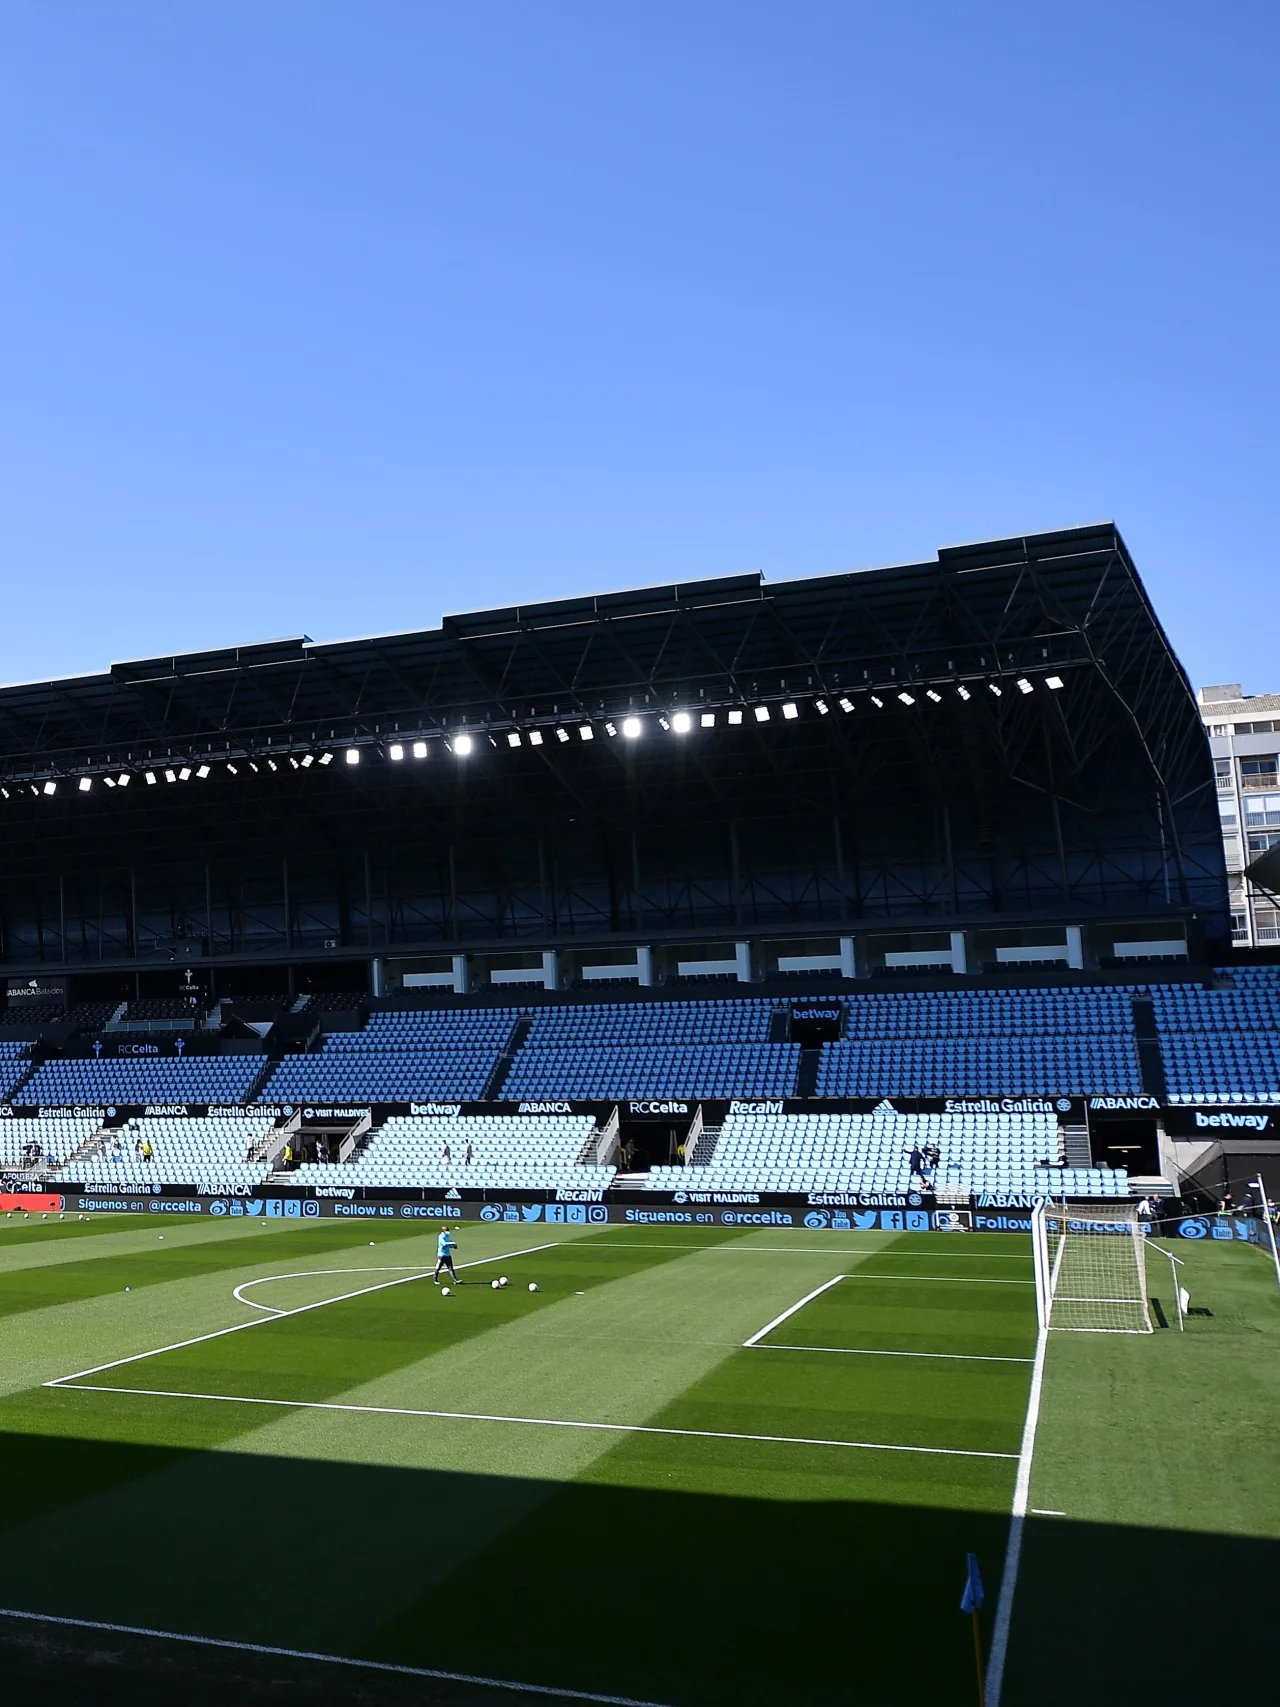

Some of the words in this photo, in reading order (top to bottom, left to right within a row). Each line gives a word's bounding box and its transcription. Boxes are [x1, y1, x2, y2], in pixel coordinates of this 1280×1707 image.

[6, 988, 35, 997] ABANCA
[792, 1008, 840, 1021] betway
[118, 1043, 158, 1054] RCCelta
[410, 1102, 461, 1117] betway
[518, 1102, 572, 1113] ABANCA
[630, 1101, 688, 1114] RCCelta
[729, 1100, 784, 1114] Recalvi
[944, 1098, 1000, 1113] Estrella
[1000, 1098, 1053, 1113] Galicia
[1089, 1097, 1160, 1110] ABANCA
[38, 1107, 72, 1118] Estrella
[73, 1106, 105, 1118] Galicia
[145, 1105, 188, 1116] ABANCA
[207, 1105, 245, 1117] Estrella
[245, 1105, 281, 1117] Galicia
[315, 1108, 333, 1117] VISIT
[334, 1108, 369, 1118] MALDIVES
[1194, 1111, 1269, 1131] betway
[84, 1183, 117, 1194] Estrella
[118, 1183, 151, 1194] Galicia
[197, 1183, 251, 1196] ABANCA
[315, 1186, 355, 1199] betway
[555, 1189, 603, 1202] Recalvi
[689, 1192, 712, 1203] VISIT
[713, 1192, 760, 1204] MALDIVES
[807, 1193, 857, 1206] Estrella
[858, 1193, 906, 1207] Galicia
[78, 1198, 128, 1211] Síguenos
[130, 1201, 143, 1209] en
[148, 1200, 202, 1213] @rccelta
[333, 1203, 378, 1216] Follow
[380, 1206, 394, 1216] us
[400, 1204, 461, 1218] @rccelta
[625, 1209, 692, 1224] Síguenos
[696, 1212, 714, 1222] en
[721, 1211, 793, 1226] @rccelta
[975, 1216, 1032, 1230] Follow
